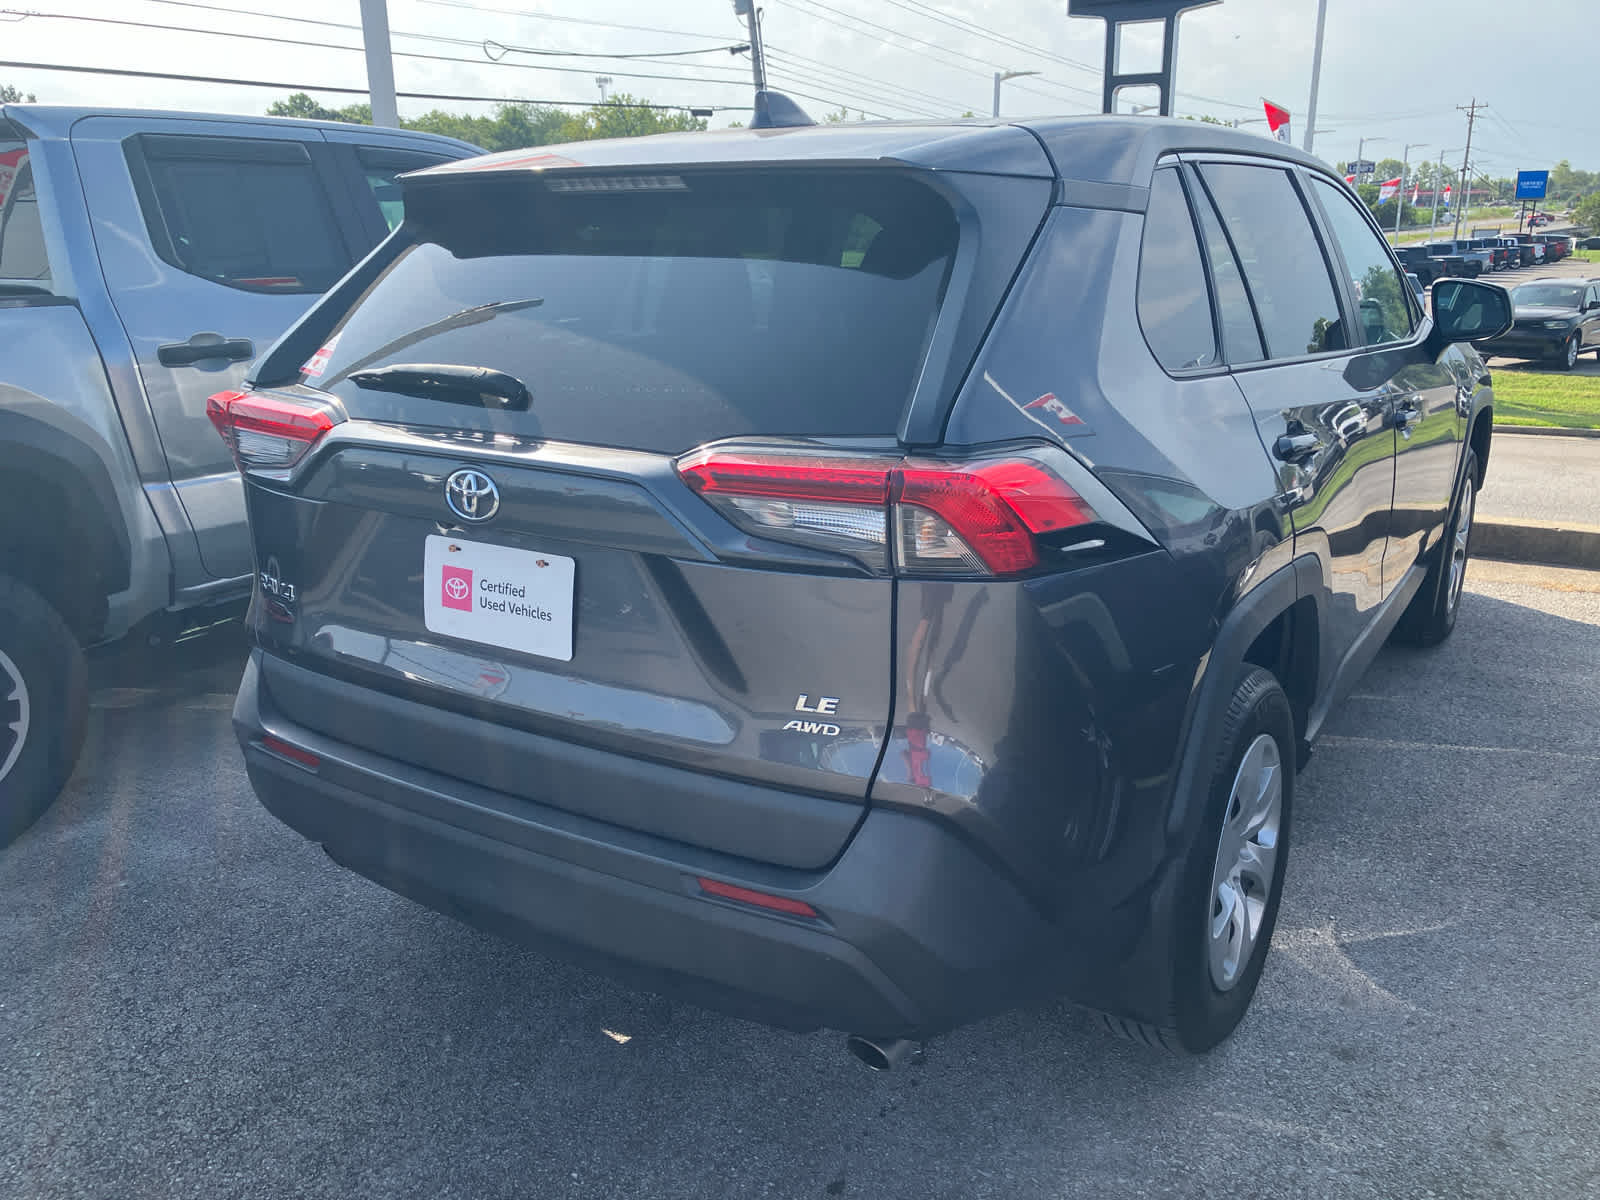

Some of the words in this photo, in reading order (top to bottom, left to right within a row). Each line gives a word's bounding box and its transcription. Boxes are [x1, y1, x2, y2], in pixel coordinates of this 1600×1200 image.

[480, 579, 525, 598] Certified
[480, 596, 506, 612] Used
[508, 601, 552, 622] Vehicles
[795, 693, 840, 715] LE
[782, 720, 841, 736] AWD
